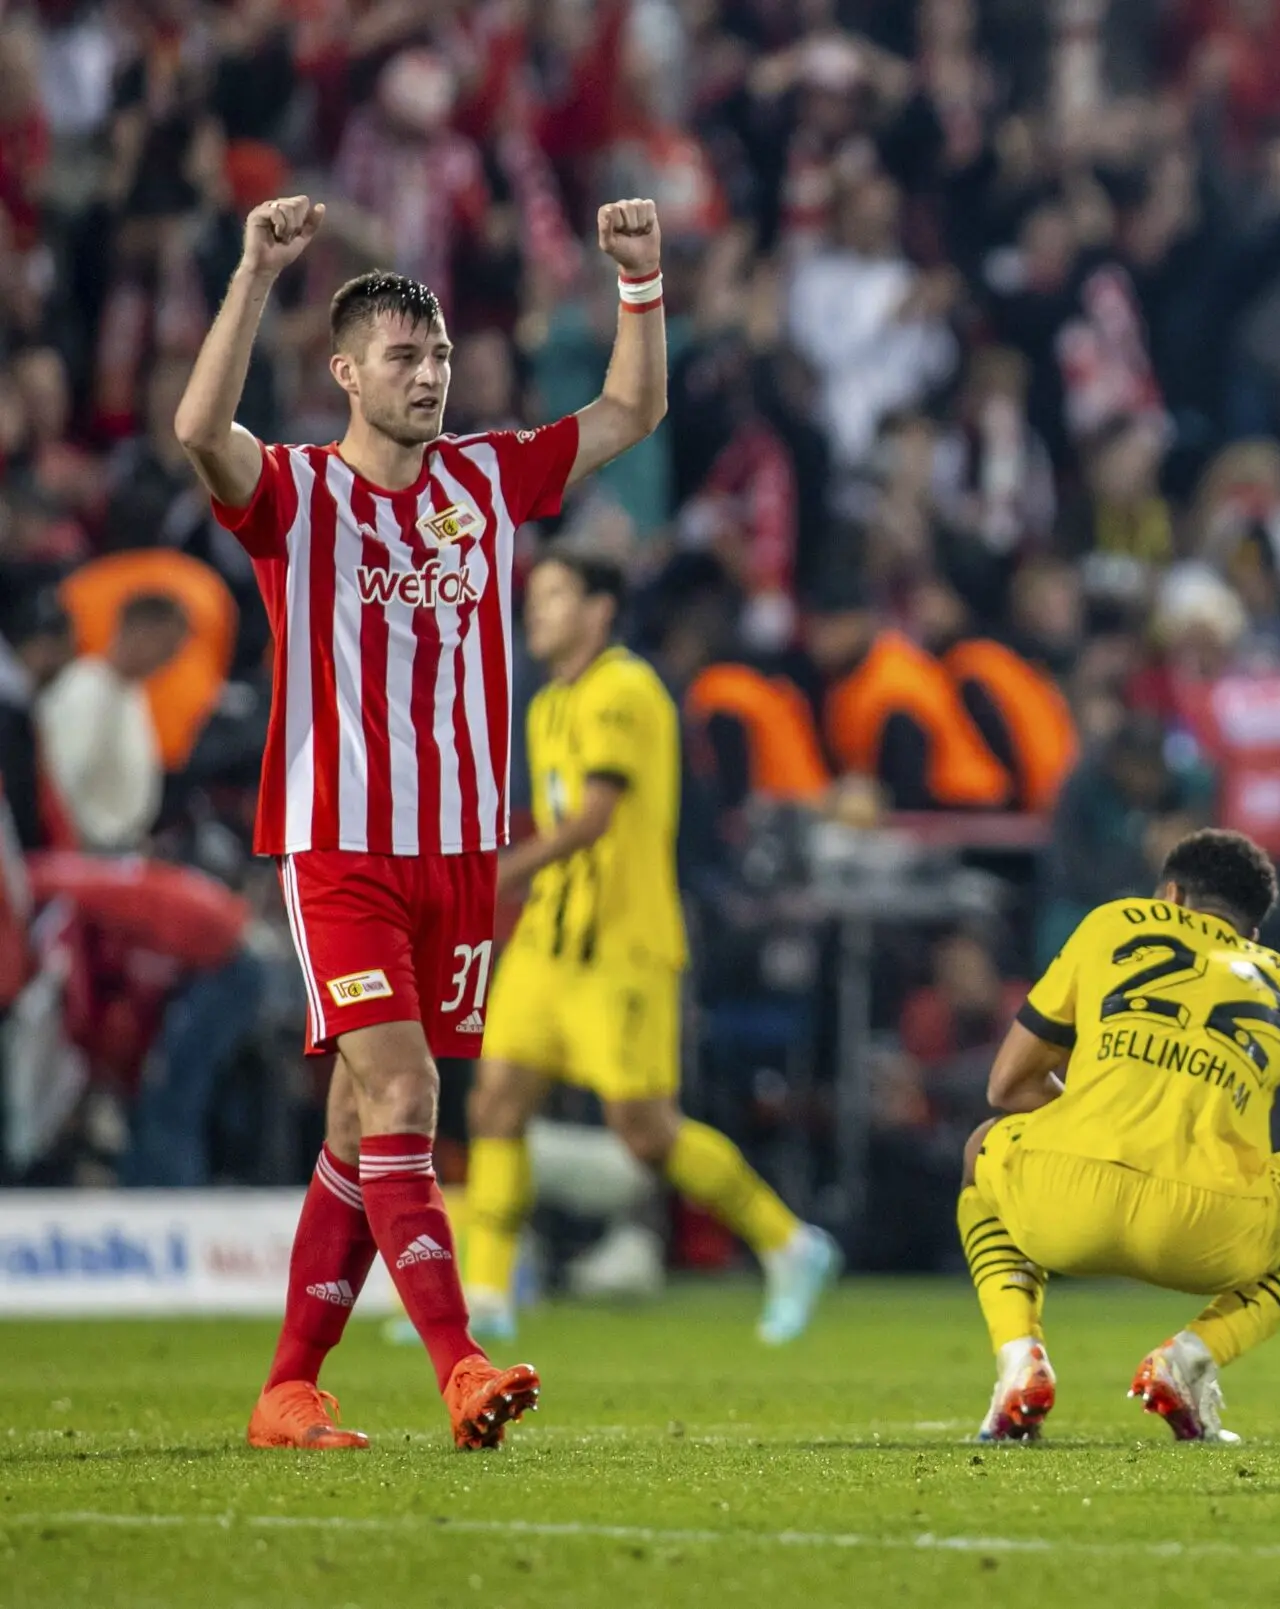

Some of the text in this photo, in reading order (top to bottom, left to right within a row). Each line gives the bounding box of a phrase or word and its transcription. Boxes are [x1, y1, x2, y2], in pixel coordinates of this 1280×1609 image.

[440, 939, 492, 1013] 31
[1097, 1029, 1252, 1117] BELLINGHAM
[396, 1249, 452, 1269] adidas
